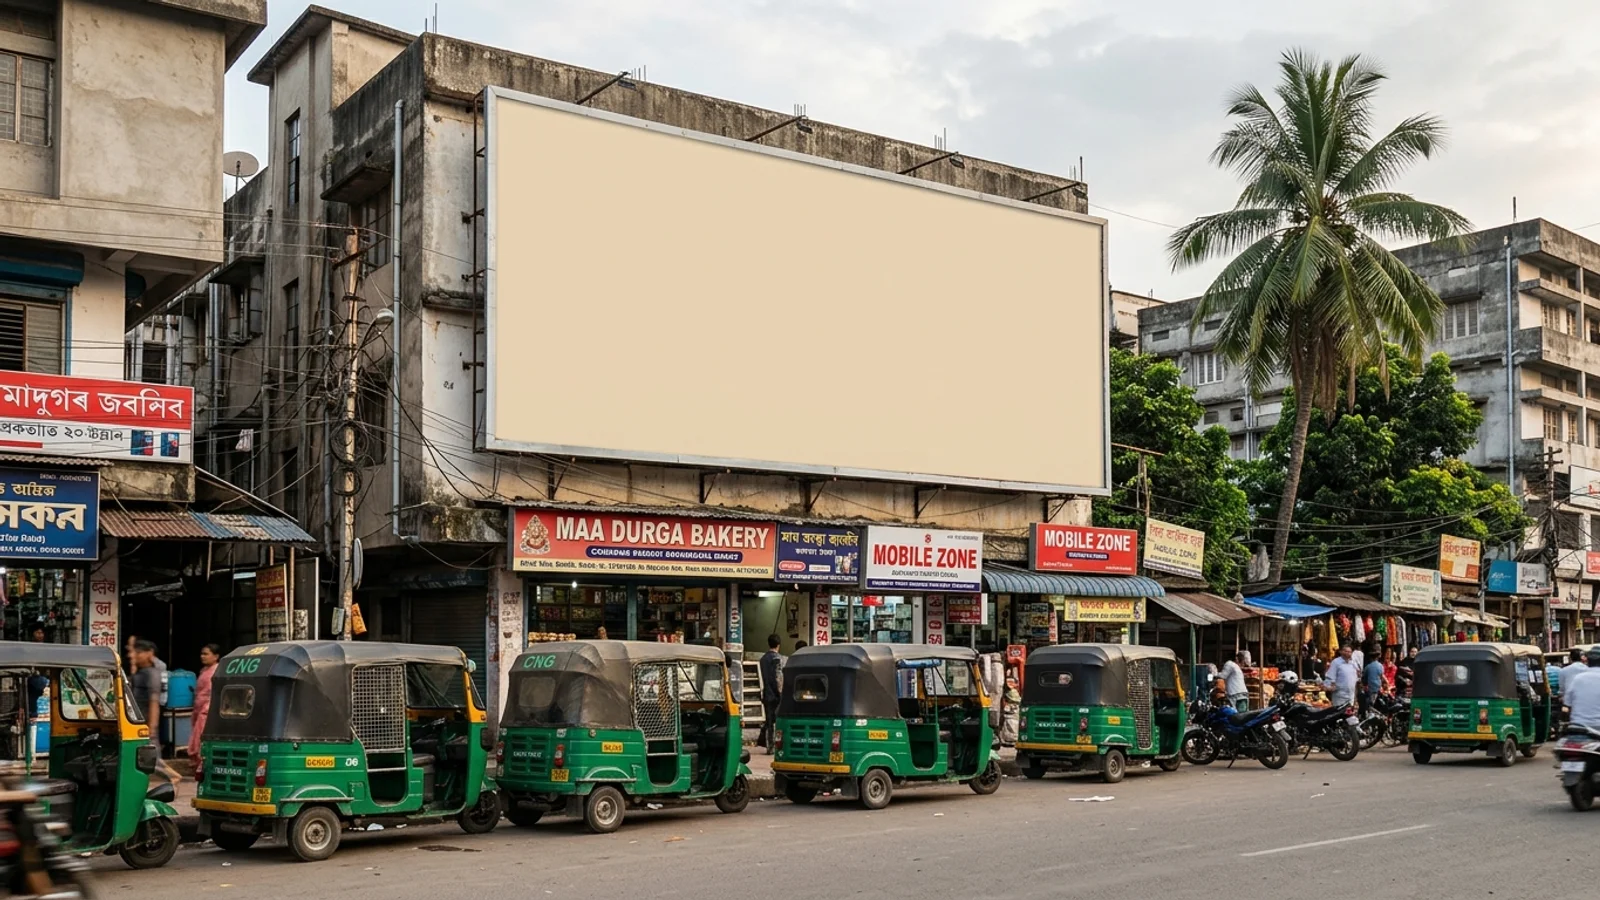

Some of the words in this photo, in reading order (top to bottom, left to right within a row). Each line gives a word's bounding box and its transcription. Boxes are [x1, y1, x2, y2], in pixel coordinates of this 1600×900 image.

[556, 516, 605, 540] MAA
[611, 519, 685, 545] DURGA
[690, 523, 769, 549] BAKERY
[1044, 530, 1093, 549] MOBILE
[1096, 533, 1131, 551] ZONE
[873, 544, 933, 567] MOBILE
[936, 548, 977, 569] ZONE
[225, 658, 261, 674] CNG
[523, 655, 556, 668] CNG
